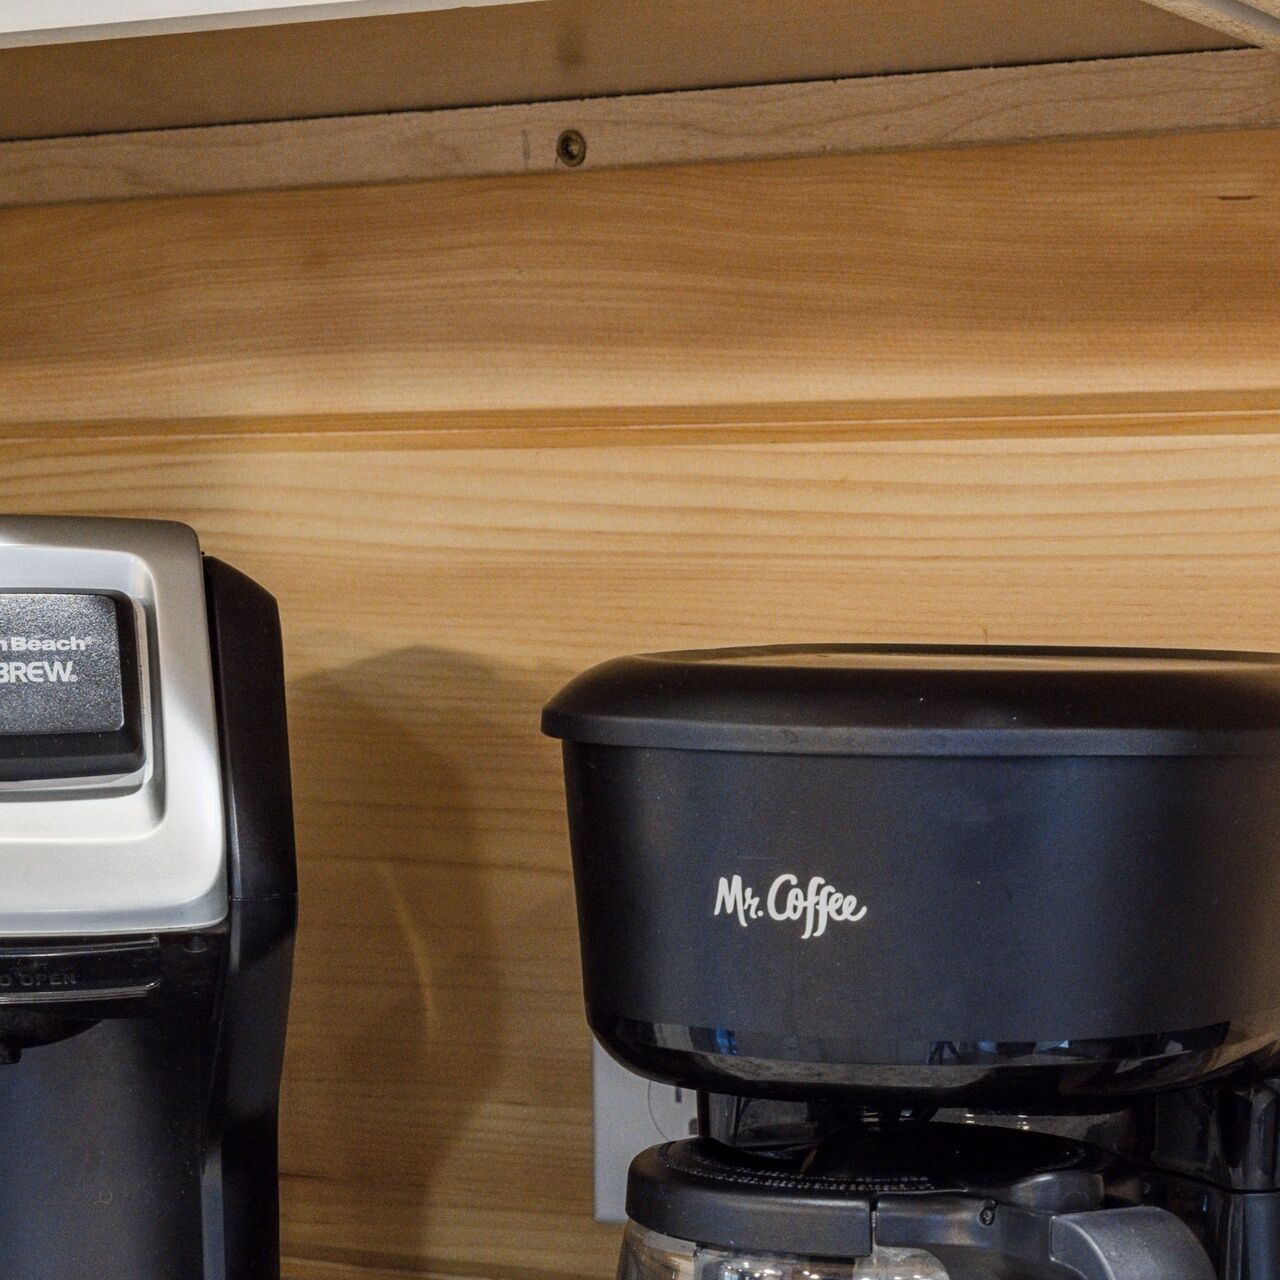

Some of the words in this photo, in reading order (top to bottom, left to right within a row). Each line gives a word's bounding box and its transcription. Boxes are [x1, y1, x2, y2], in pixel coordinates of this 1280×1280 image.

[713, 874, 764, 927] Mr.
[766, 873, 868, 939] Coffee
[20, 973, 77, 986] OPEN
